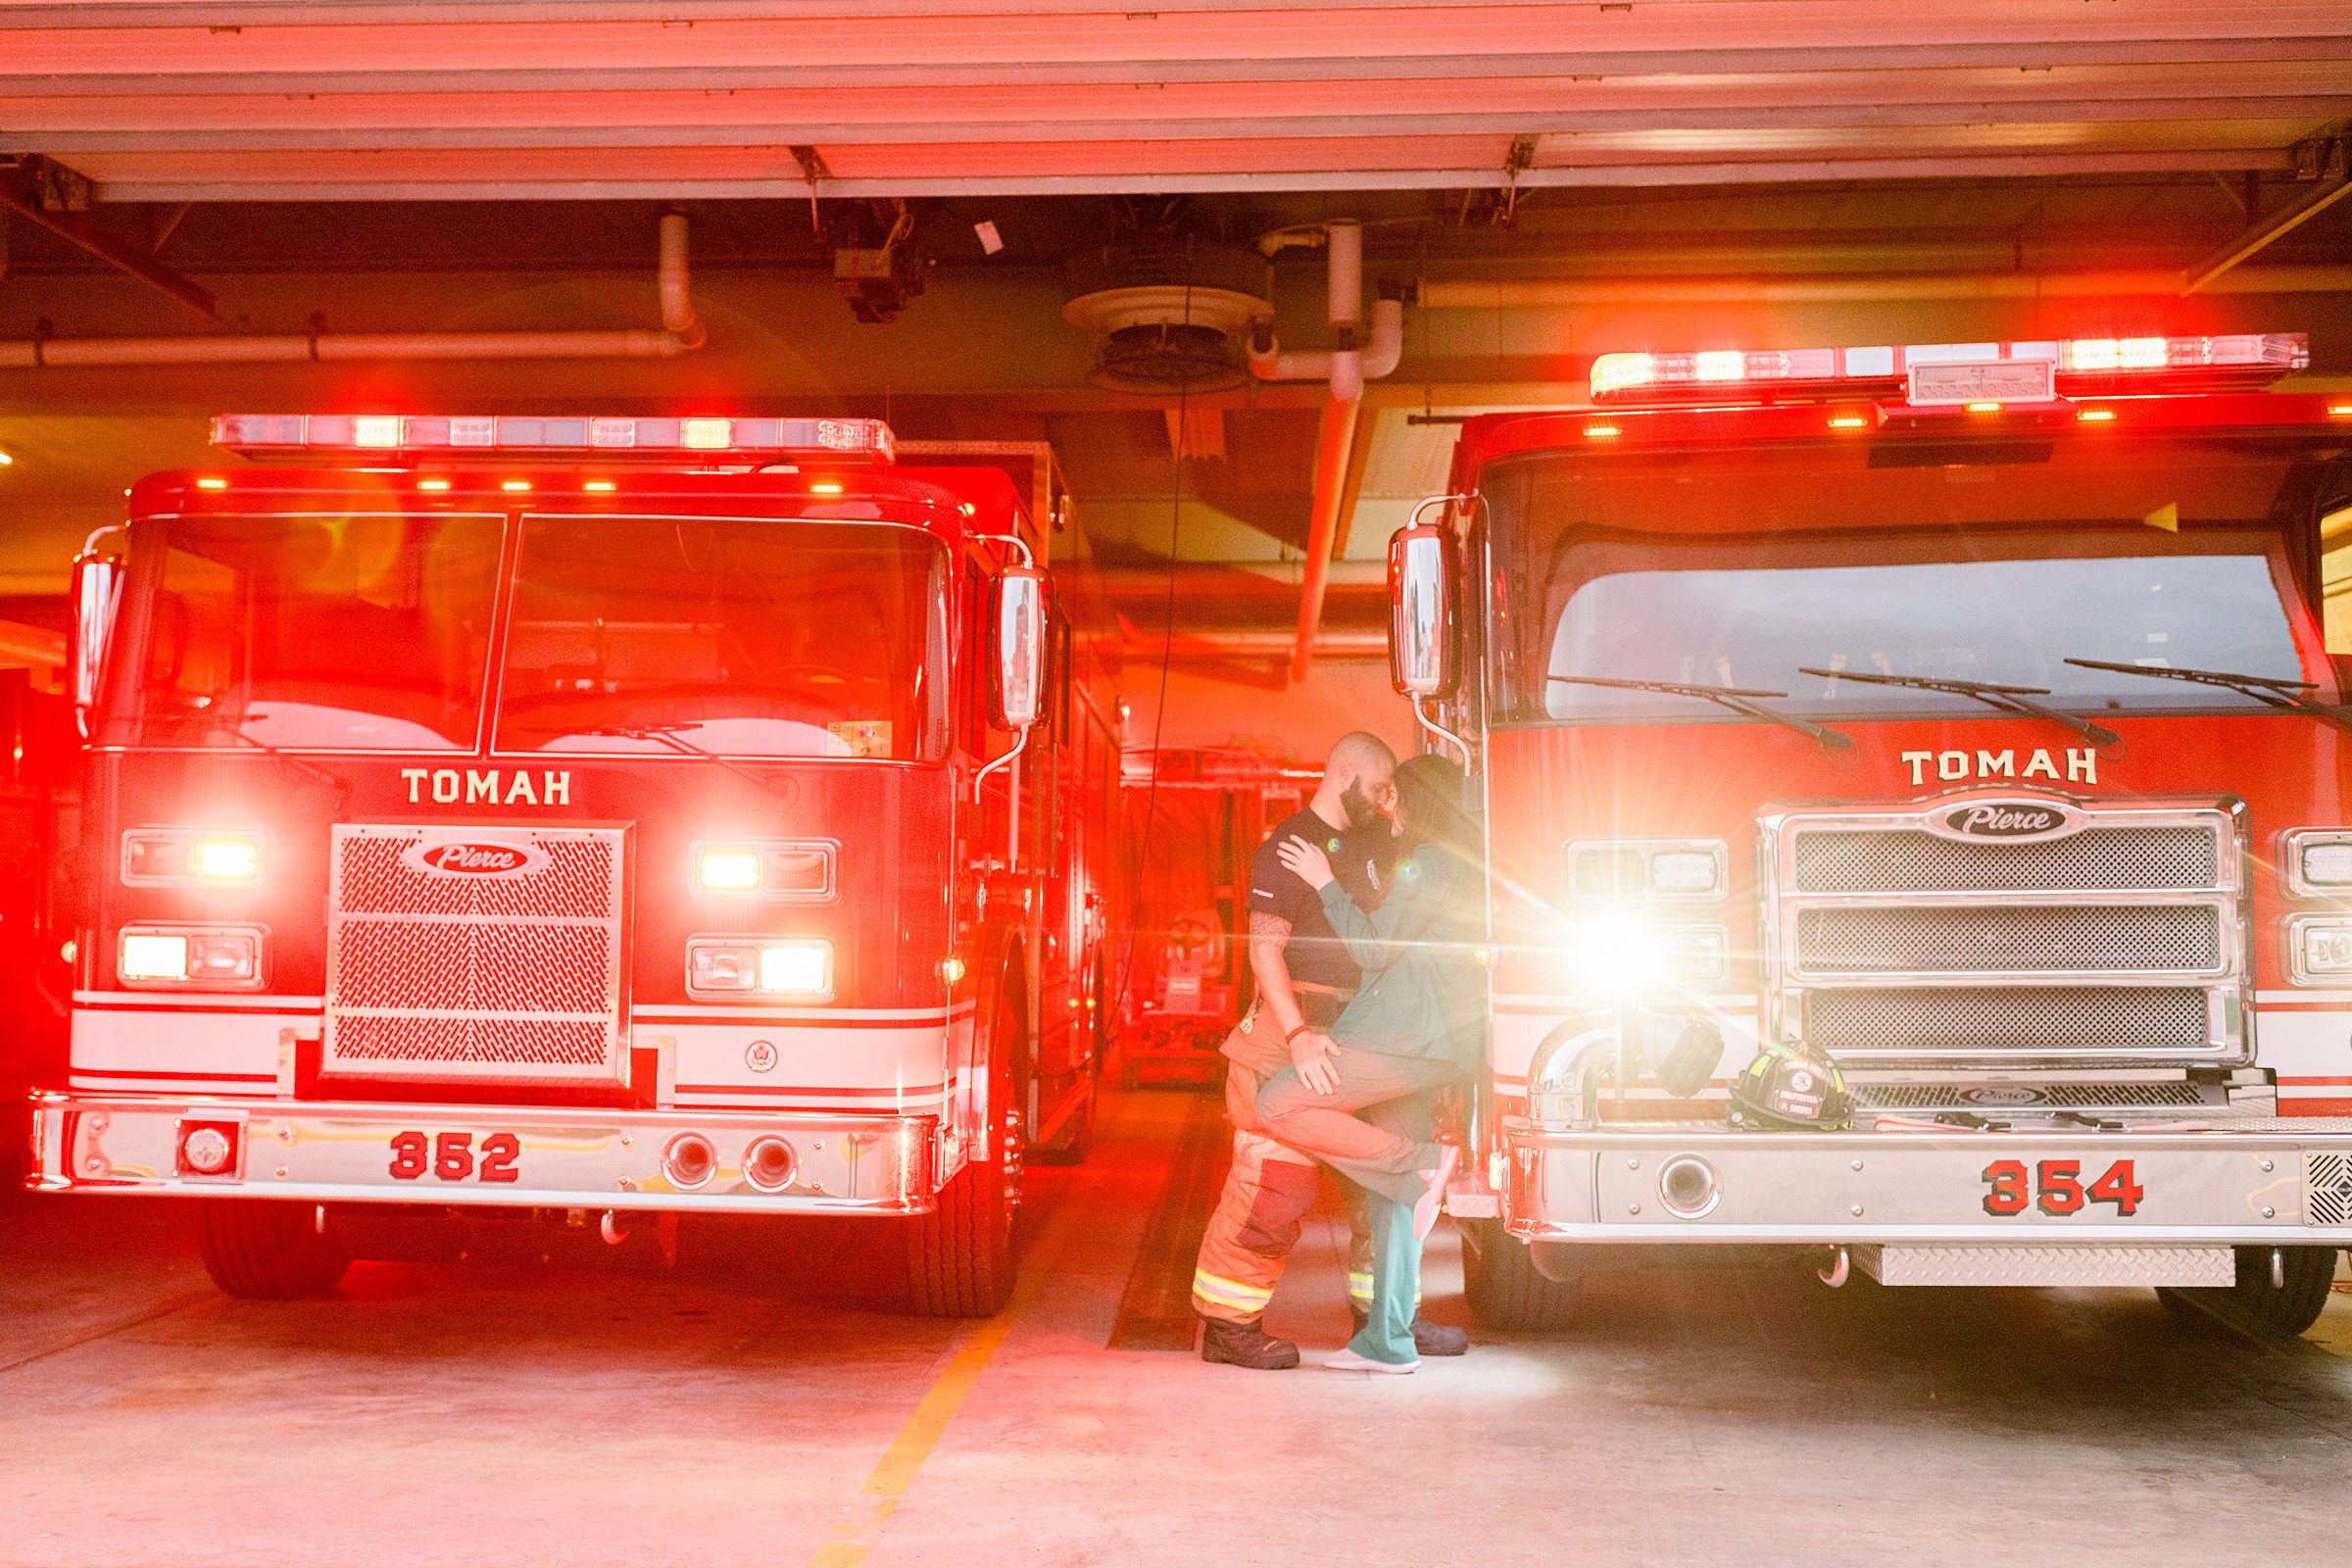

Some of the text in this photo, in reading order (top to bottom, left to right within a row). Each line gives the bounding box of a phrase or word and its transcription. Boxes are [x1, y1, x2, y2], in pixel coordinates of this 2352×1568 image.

[1901, 748, 2097, 786] TOMAH
[401, 768, 570, 806] TOMAH
[1961, 806, 2051, 833] Pierce
[436, 844, 515, 870] Pierce
[389, 1131, 520, 1182] 352
[1982, 1159, 2144, 1217] 354
